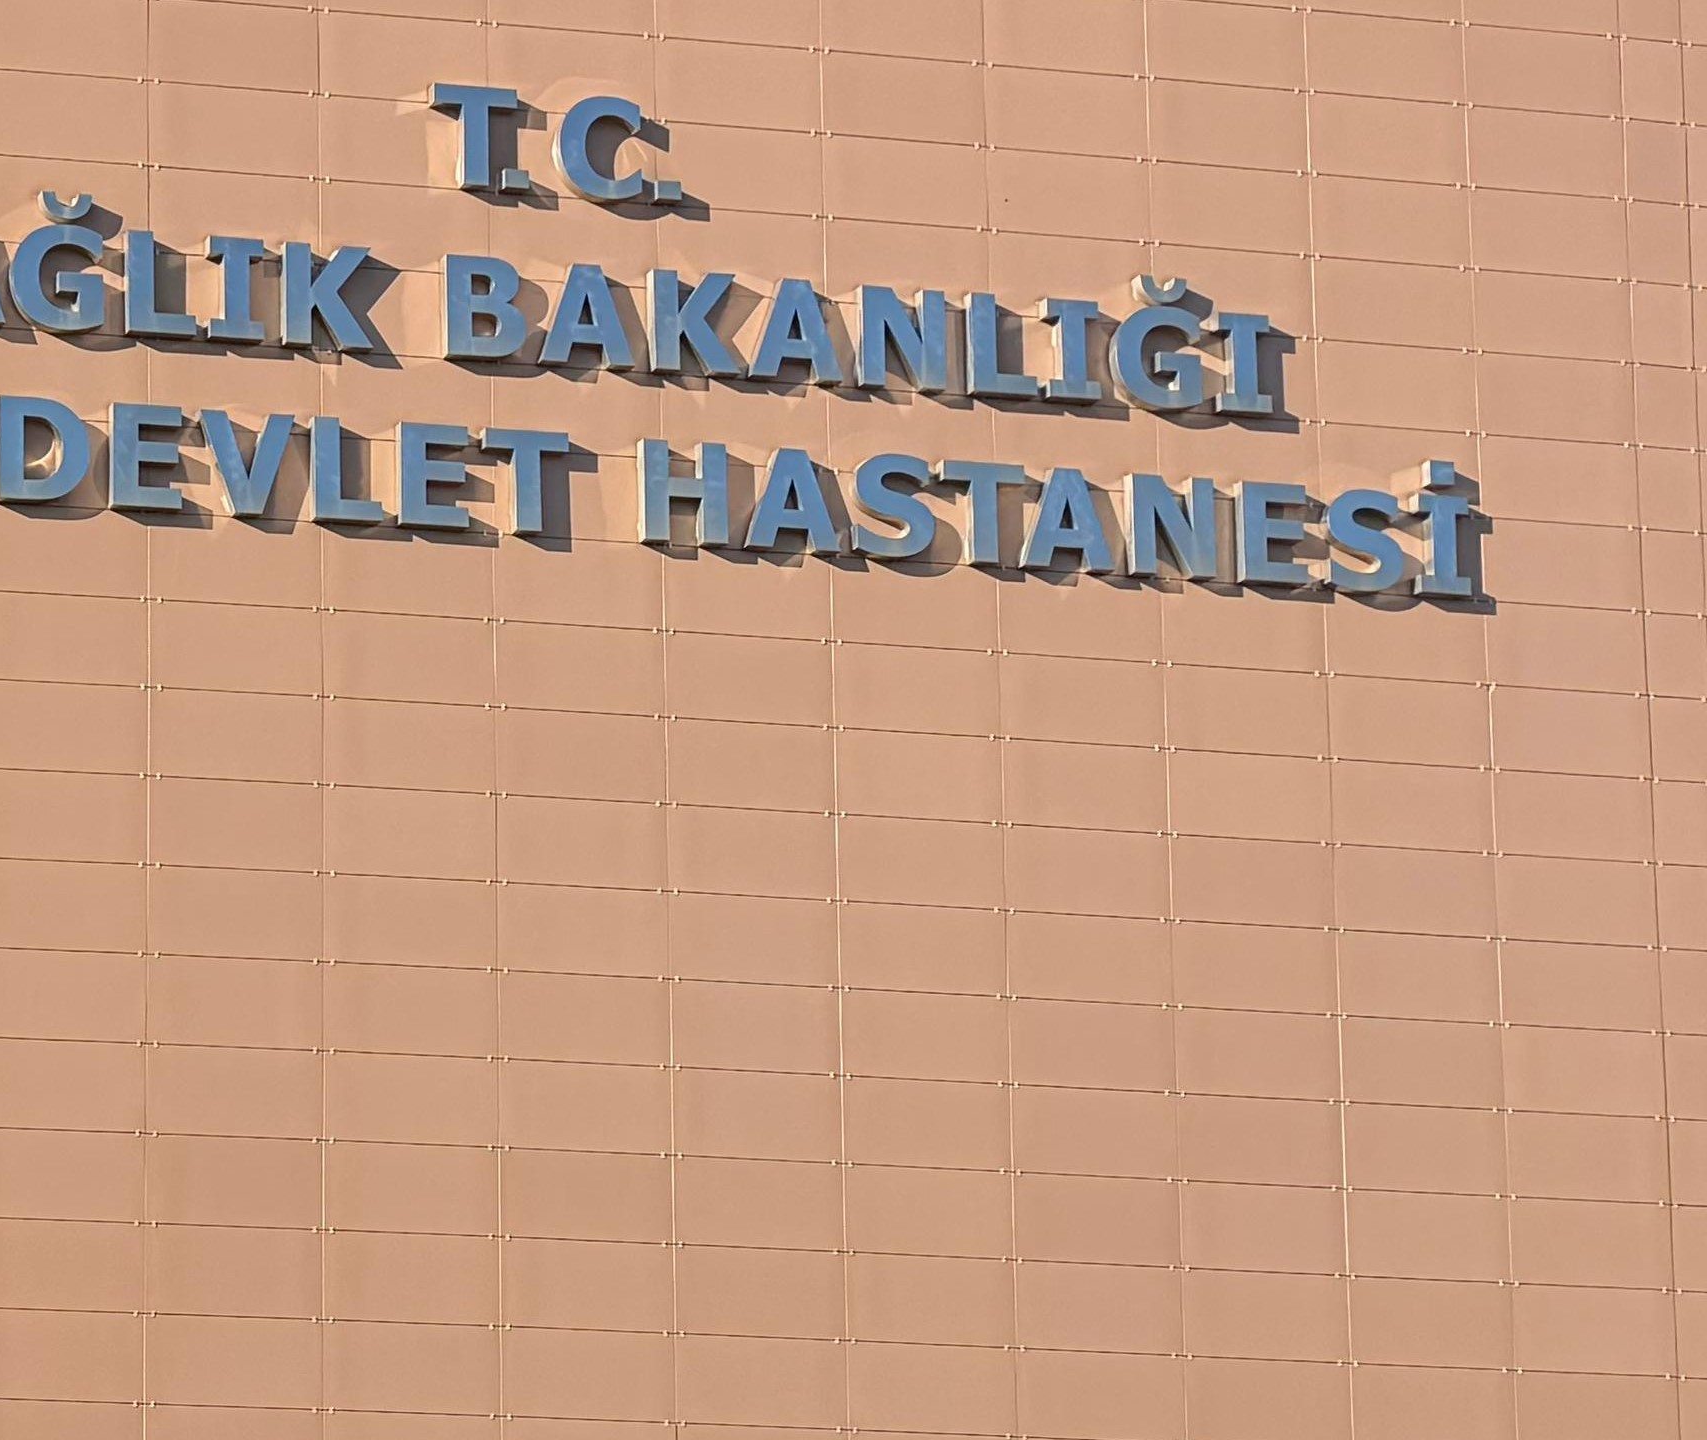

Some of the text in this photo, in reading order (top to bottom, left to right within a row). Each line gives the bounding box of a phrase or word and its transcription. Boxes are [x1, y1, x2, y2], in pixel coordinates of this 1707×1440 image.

[429, 82, 683, 202] T.C.
[441, 253, 1274, 416] BAKANLIĞI
[635, 437, 1473, 598] HASTANESİ
